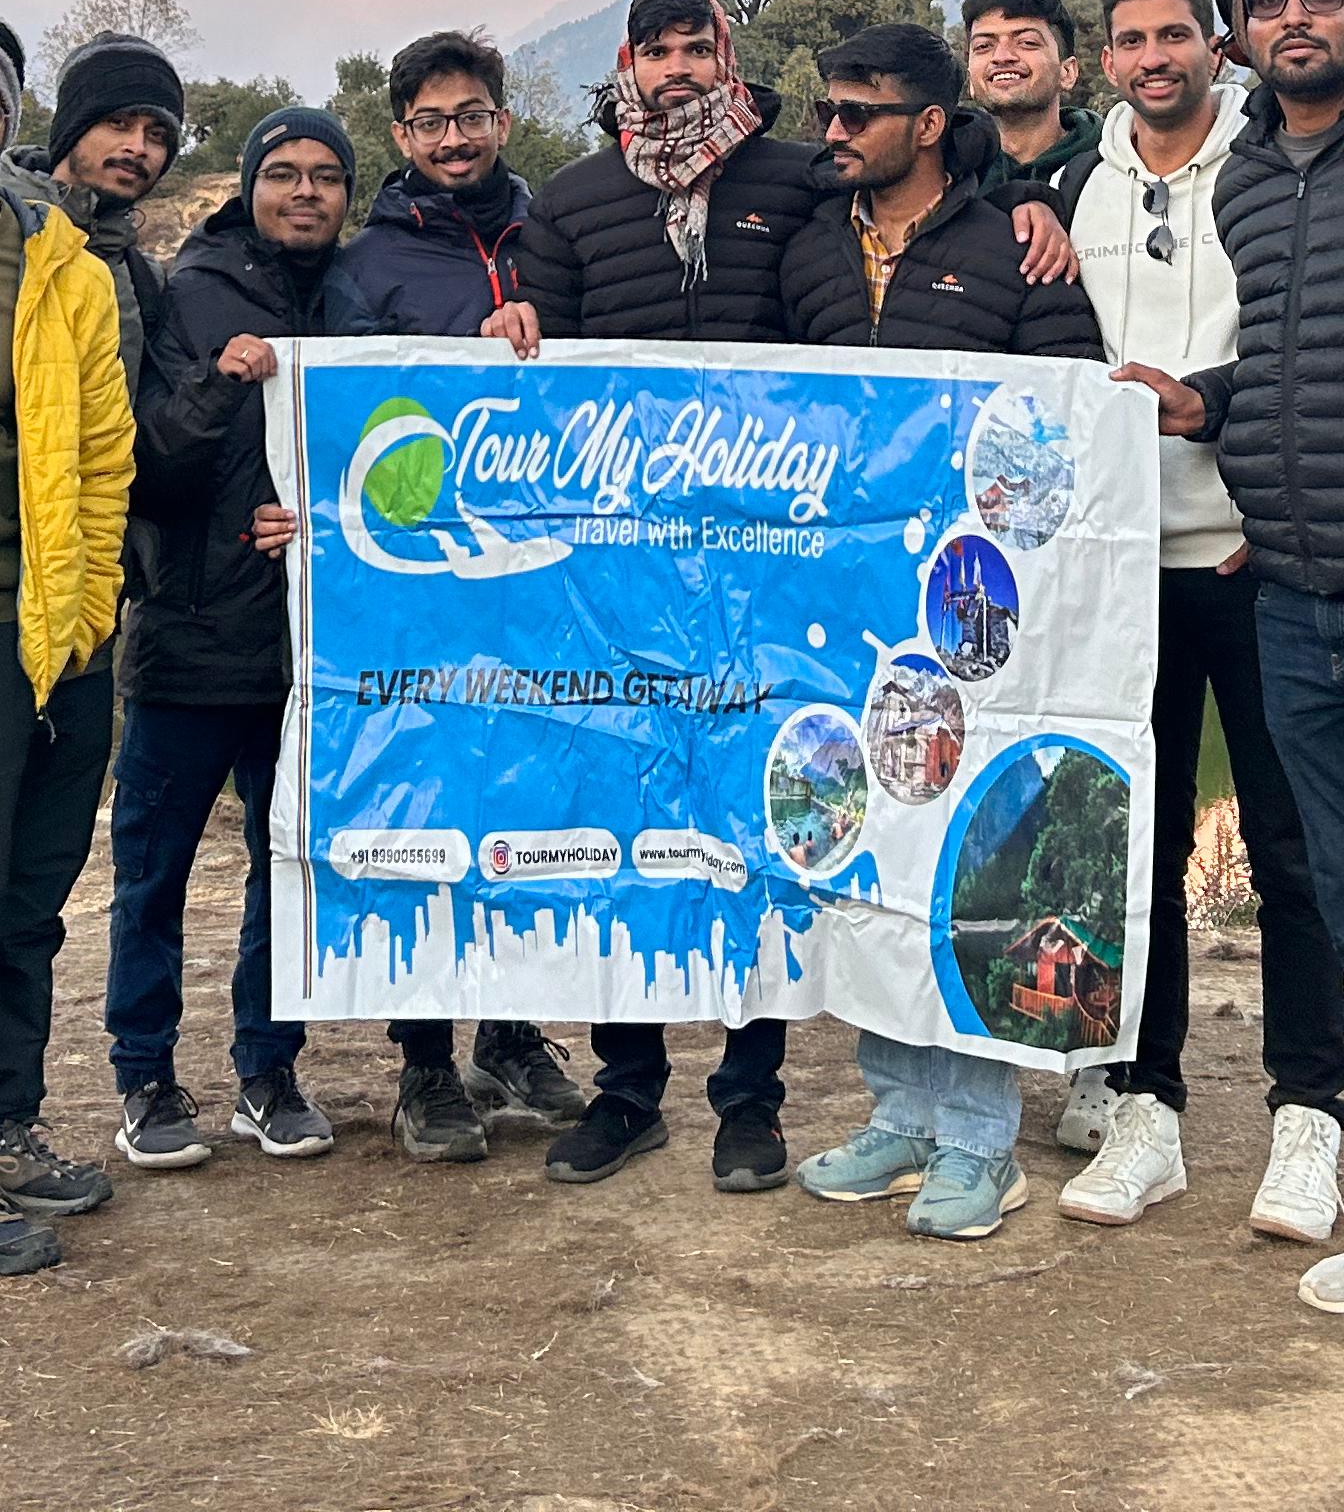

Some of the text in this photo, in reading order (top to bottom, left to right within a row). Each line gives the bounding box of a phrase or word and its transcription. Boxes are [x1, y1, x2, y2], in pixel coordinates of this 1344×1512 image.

[453, 396, 840, 525] Tour My Holiday
[701, 515, 826, 559] Excellence
[357, 667, 774, 714] EVERY WEEKEND GETAWAY
[515, 846, 618, 865] TOURMYHOLIDAY
